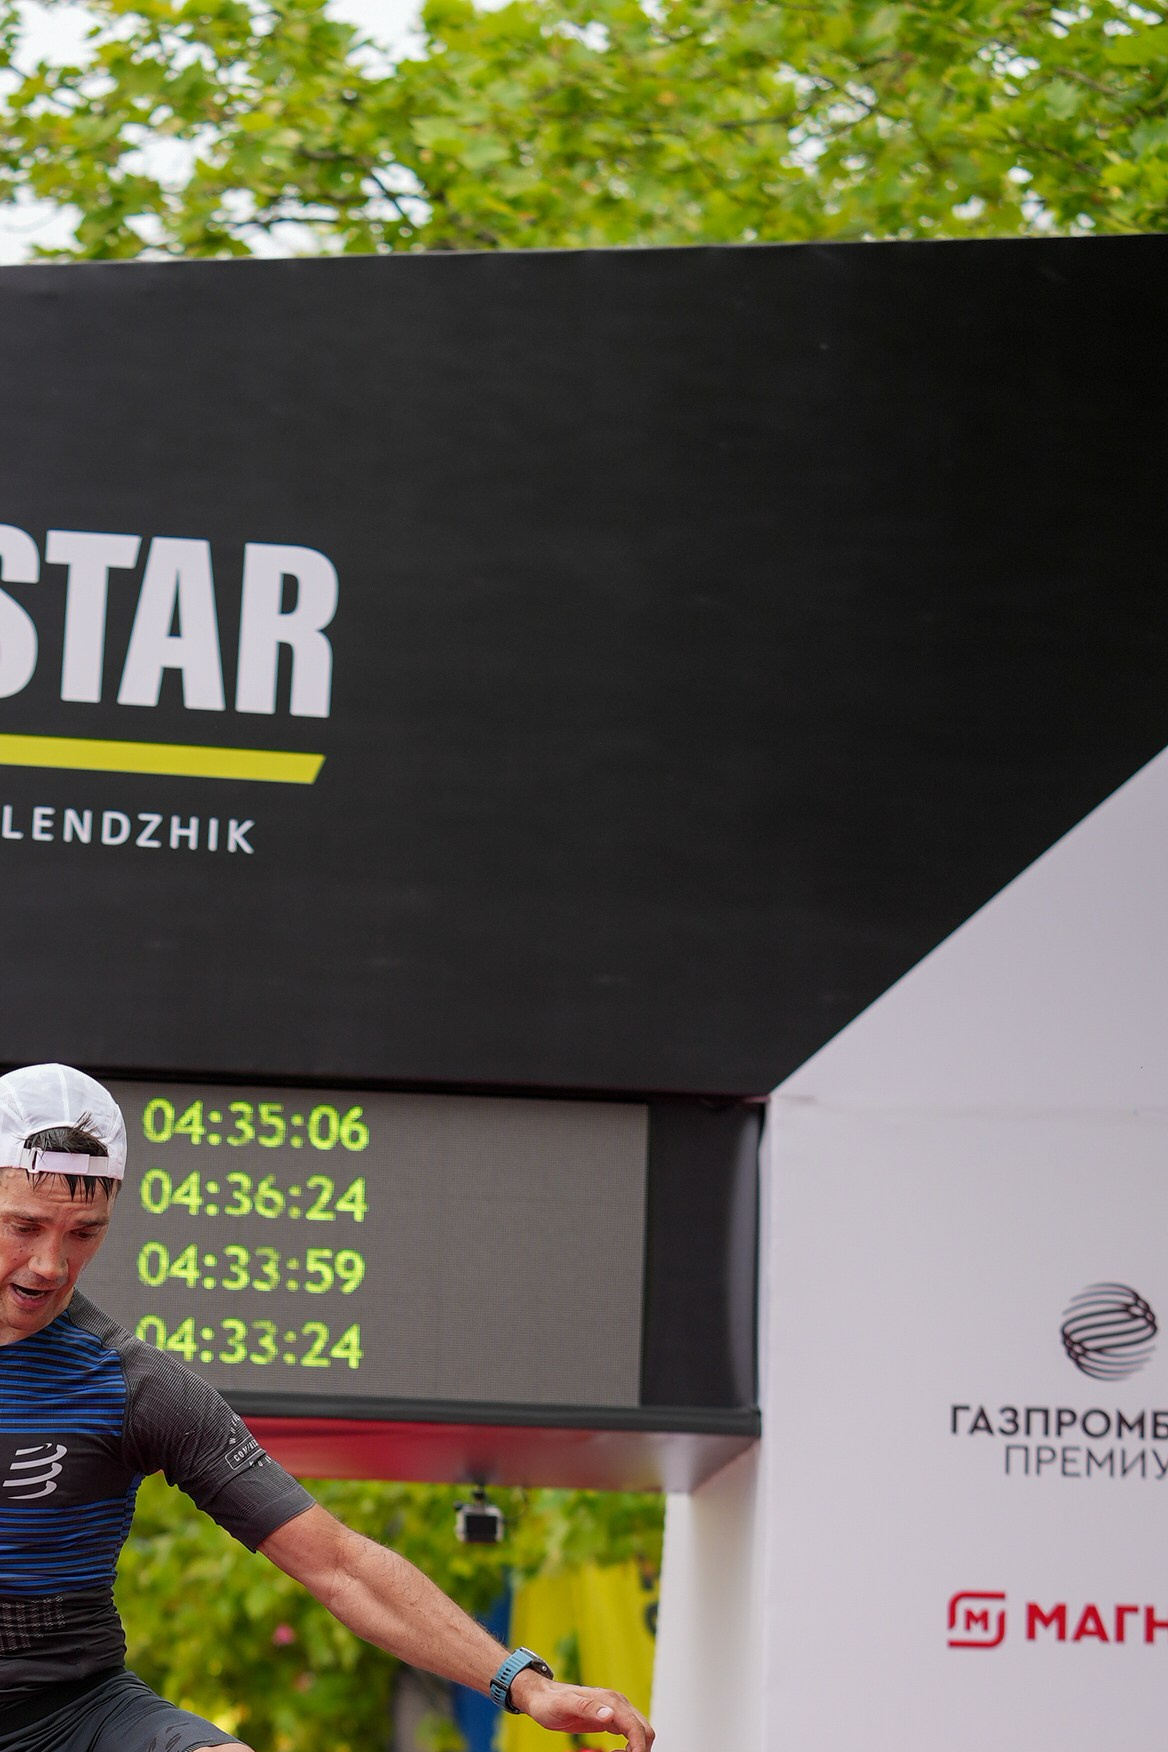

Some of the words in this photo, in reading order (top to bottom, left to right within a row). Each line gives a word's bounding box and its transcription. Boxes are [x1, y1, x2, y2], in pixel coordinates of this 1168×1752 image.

[142, 1097, 370, 1152] 04:35:06
[140, 1168, 369, 1222] 04:36:24
[137, 1241, 366, 1295] 04:33:59
[135, 1314, 364, 1369] 04:33:24
[949, 1404, 1168, 1441] ГАЗПРОМБ
